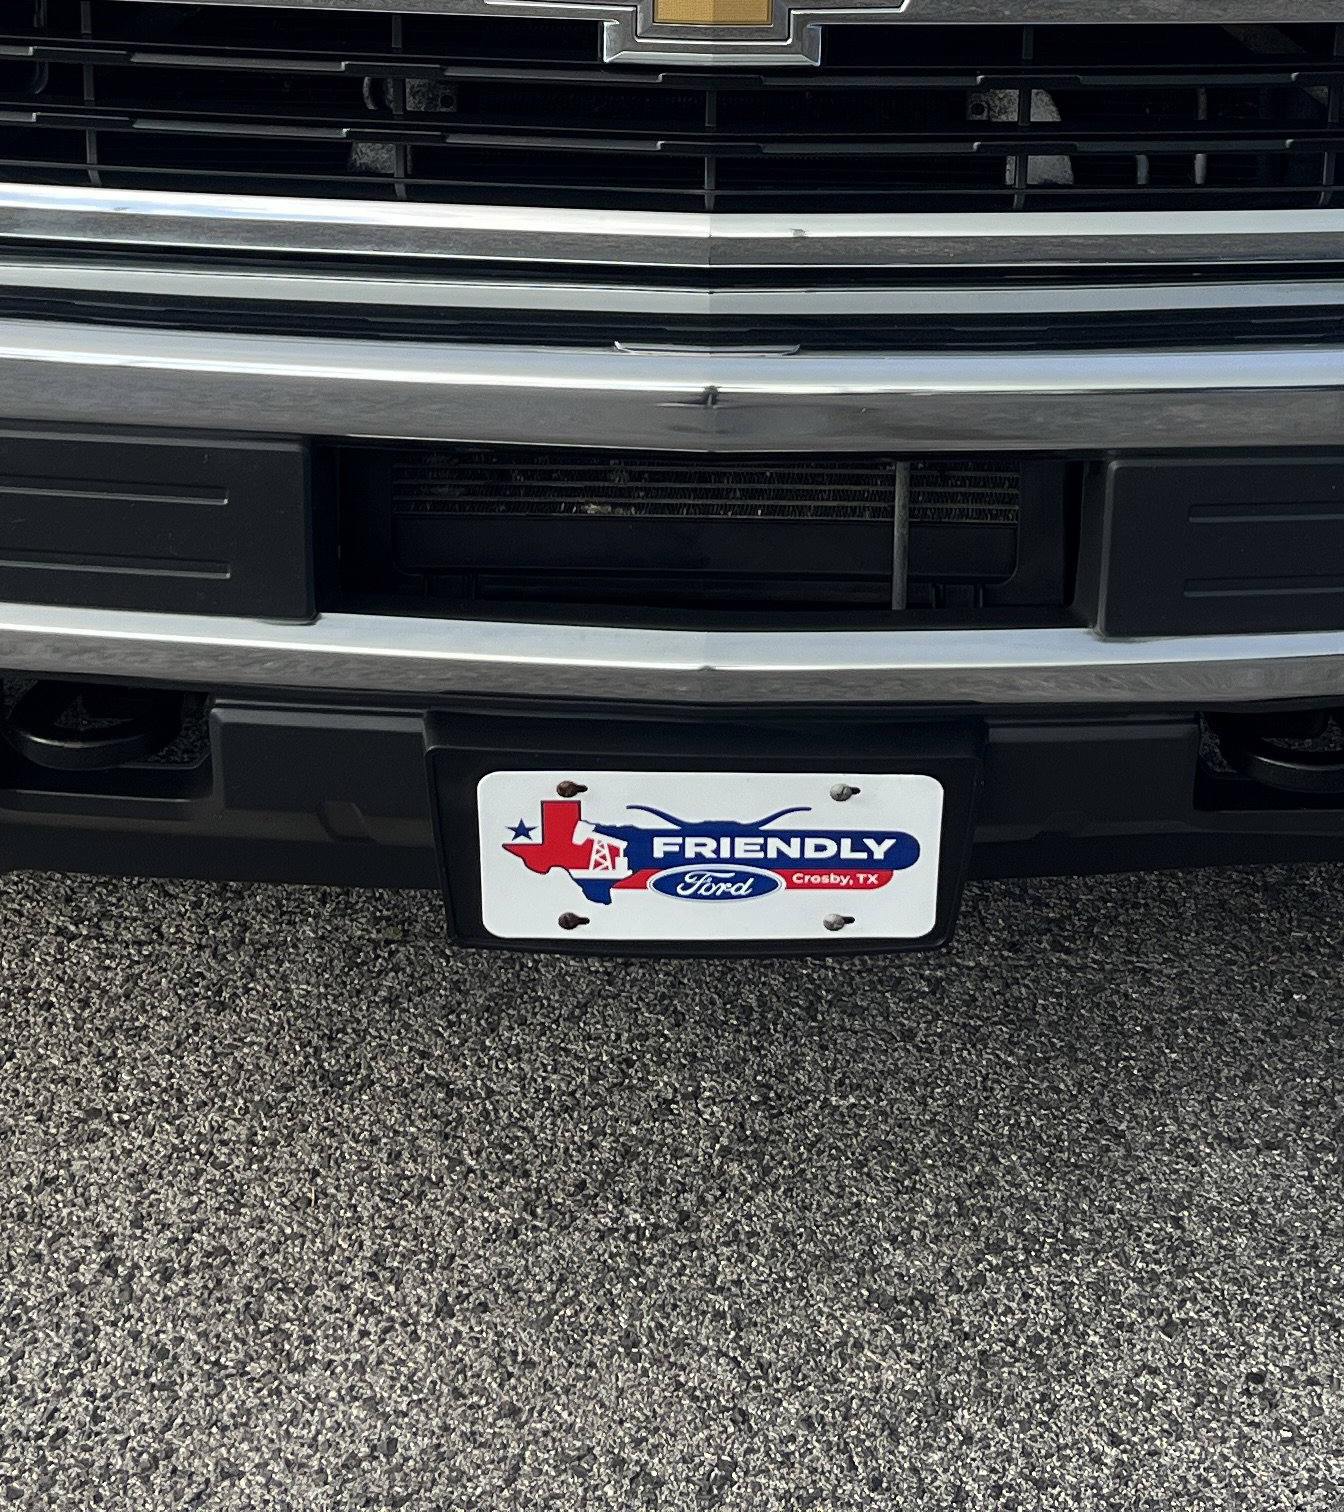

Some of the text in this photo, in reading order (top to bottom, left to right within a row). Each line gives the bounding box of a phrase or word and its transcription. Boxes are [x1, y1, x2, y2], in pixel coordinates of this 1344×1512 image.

[652, 836, 898, 861] FRIENDLY
[676, 870, 755, 897] Ford
[791, 871, 879, 887] Crosby, TX
